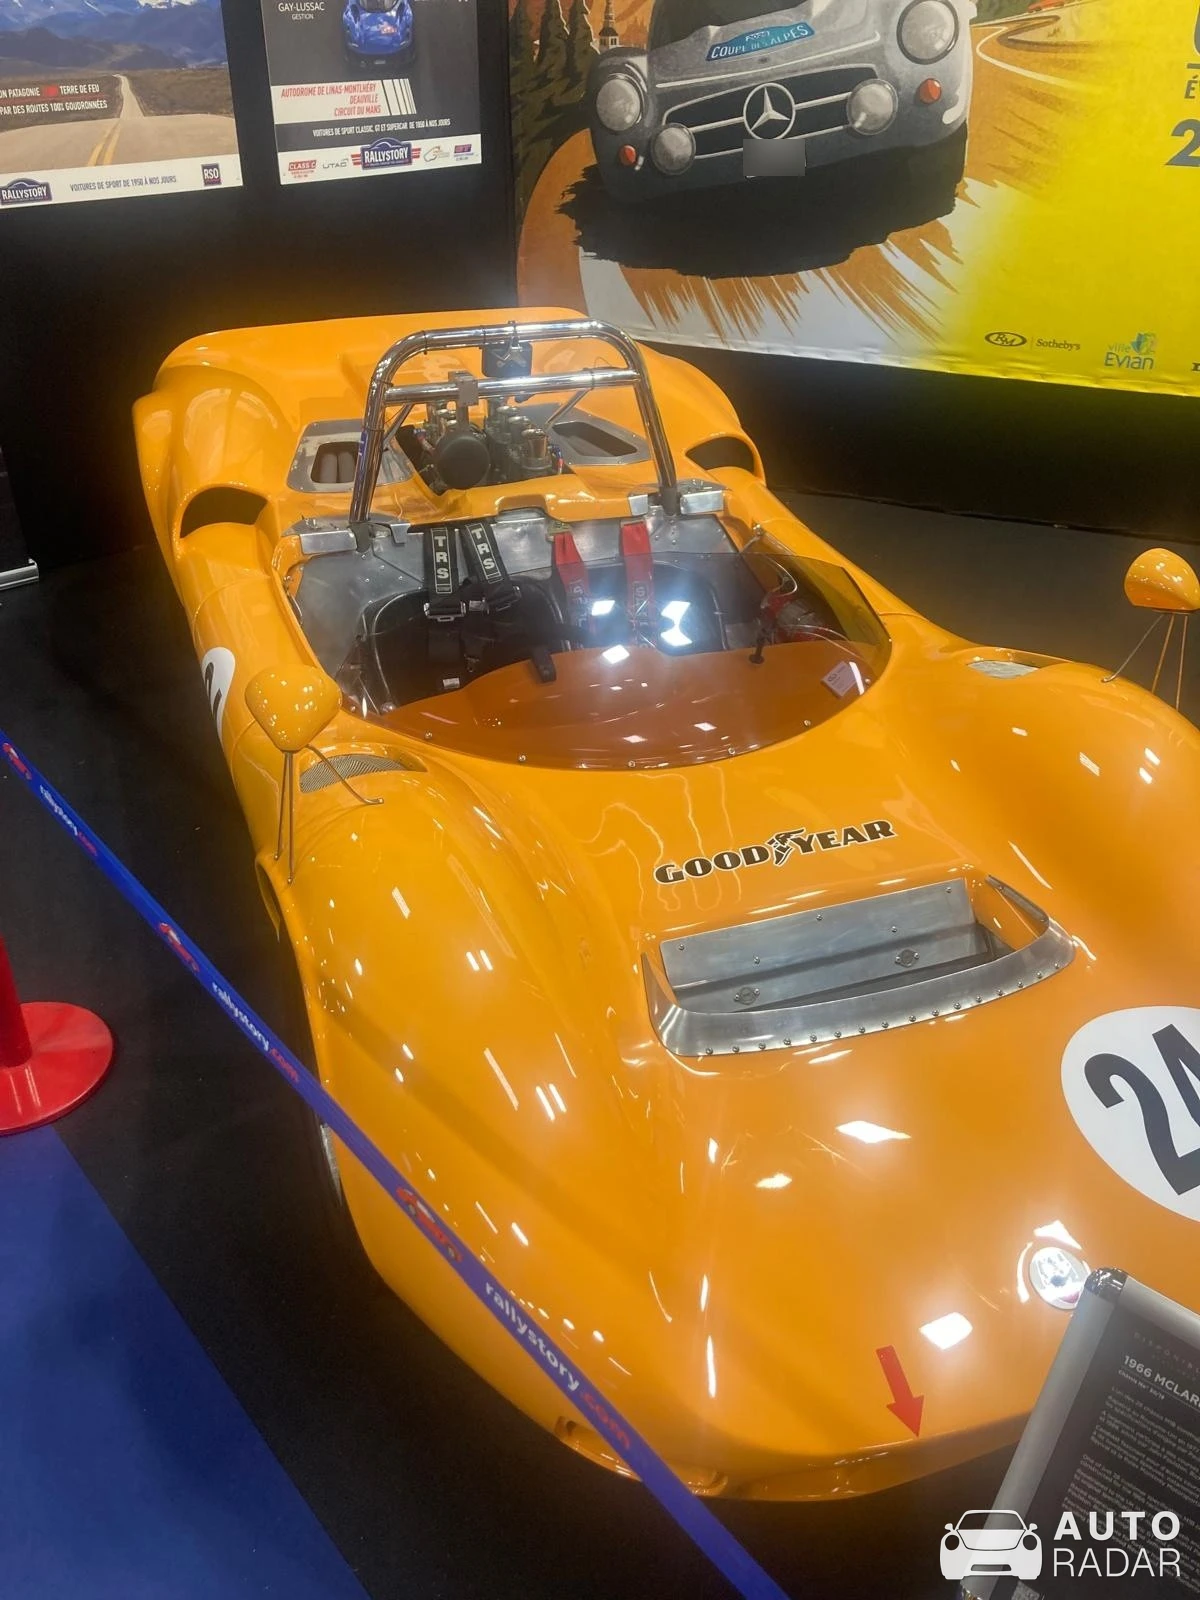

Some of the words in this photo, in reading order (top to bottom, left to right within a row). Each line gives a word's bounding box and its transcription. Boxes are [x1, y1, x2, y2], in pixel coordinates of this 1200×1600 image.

[278, 1, 325, 12] GAY-LUSSAC
[769, 25, 809, 50] ALPES
[8, 87, 41, 98] PATAGONIE
[59, 85, 79, 95] TERRE
[79, 84, 88, 93] DE
[88, 84, 100, 93] FEU
[281, 86, 317, 98] AUTODROME
[317, 86, 325, 95] DE
[349, 94, 378, 104] DEAUVILLE
[0, 106, 12, 115] PAR
[13, 105, 25, 114] DES
[26, 103, 49, 113] ROUTES
[65, 99, 108, 110] GOUDRONNÉES
[334, 106, 357, 117] CIRCUIT
[357, 105, 365, 115] DU
[365, 105, 381, 114] MANS
[312, 128, 334, 137] VOITURES
[334, 127, 341, 136] DE
[341, 126, 355, 135] SPORT
[364, 147, 409, 163] RALLYSTORY
[289, 161, 316, 170] CLASSC
[203, 169, 219, 180] RSO
[70, 181, 96, 192] VOITURES
[97, 181, 104, 189] DE
[105, 179, 122, 189] SPORT
[123, 179, 130, 188] DE
[131, 178, 143, 187] 1950
[149, 177, 160, 185] NOS
[161, 175, 177, 184] JOURS
[1, 186, 47, 200] RALLYSTORY
[1035, 338, 1081, 351] Sotheby's
[1104, 351, 1154, 370] Evian
[471, 528, 495, 570] TRS
[434, 535, 449, 579] TRS
[654, 820, 899, 885] GOODYEAR
[1123, 1355, 1152, 1379] 1966
